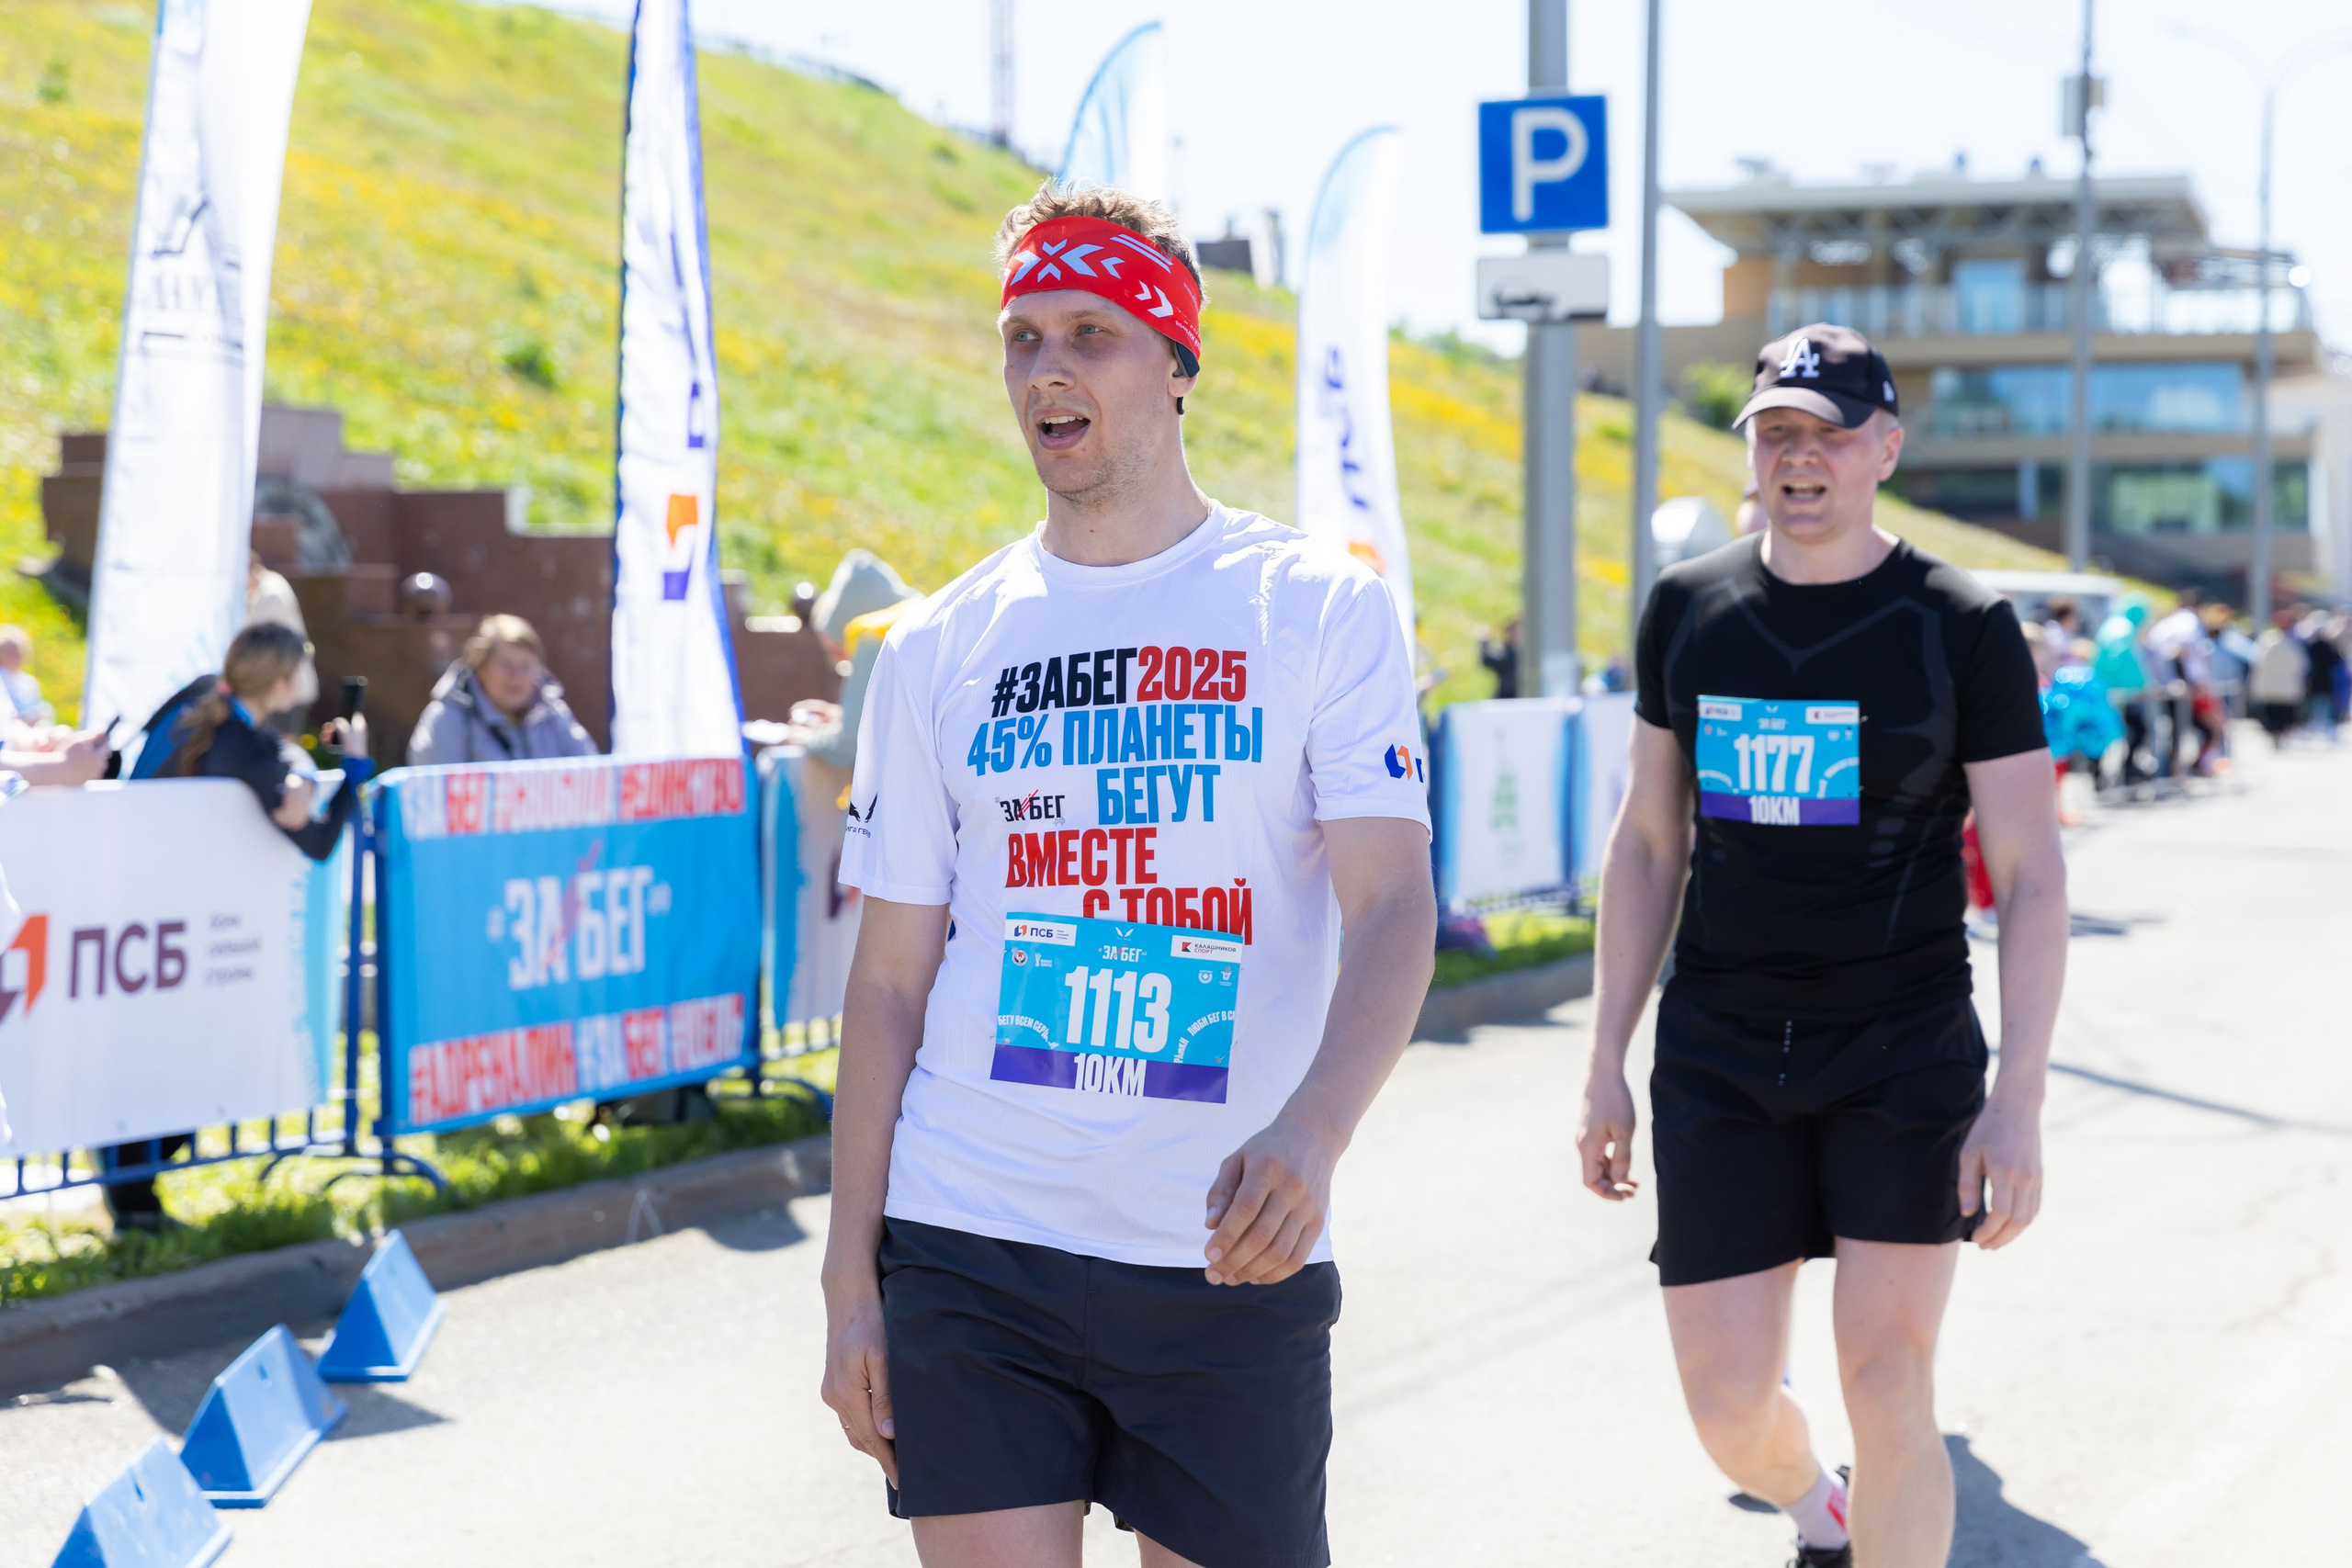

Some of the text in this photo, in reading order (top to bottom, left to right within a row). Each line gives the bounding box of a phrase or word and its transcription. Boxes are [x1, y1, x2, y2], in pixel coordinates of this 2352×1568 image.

[1511, 107, 1589, 222] P
[991, 646, 1247, 718] #ЗАБЕГ2025
[967, 704, 1263, 777] 45% ПЛАНЕТЫ
[1734, 733, 1815, 794] 1177
[1097, 764, 1221, 825] БЕГУТ
[1005, 827, 1158, 888] ВМЕСТЕ
[1030, 927, 1054, 938] ПСБ
[1119, 877, 1252, 945] ТОБОЙ
[69, 920, 190, 999] ПСБ
[1194, 942, 1237, 953] КАЛАШНИКОВ
[998, 1014, 1016, 1025] БЕГУ
[1015, 1015, 1035, 1029] ВСЕМ
[1065, 965, 1172, 1054] 1113
[1186, 1016, 1209, 1037] ЛЮБИ
[1206, 1011, 1221, 1024] БЕГ
[1221, 1010, 1227, 1021] В
